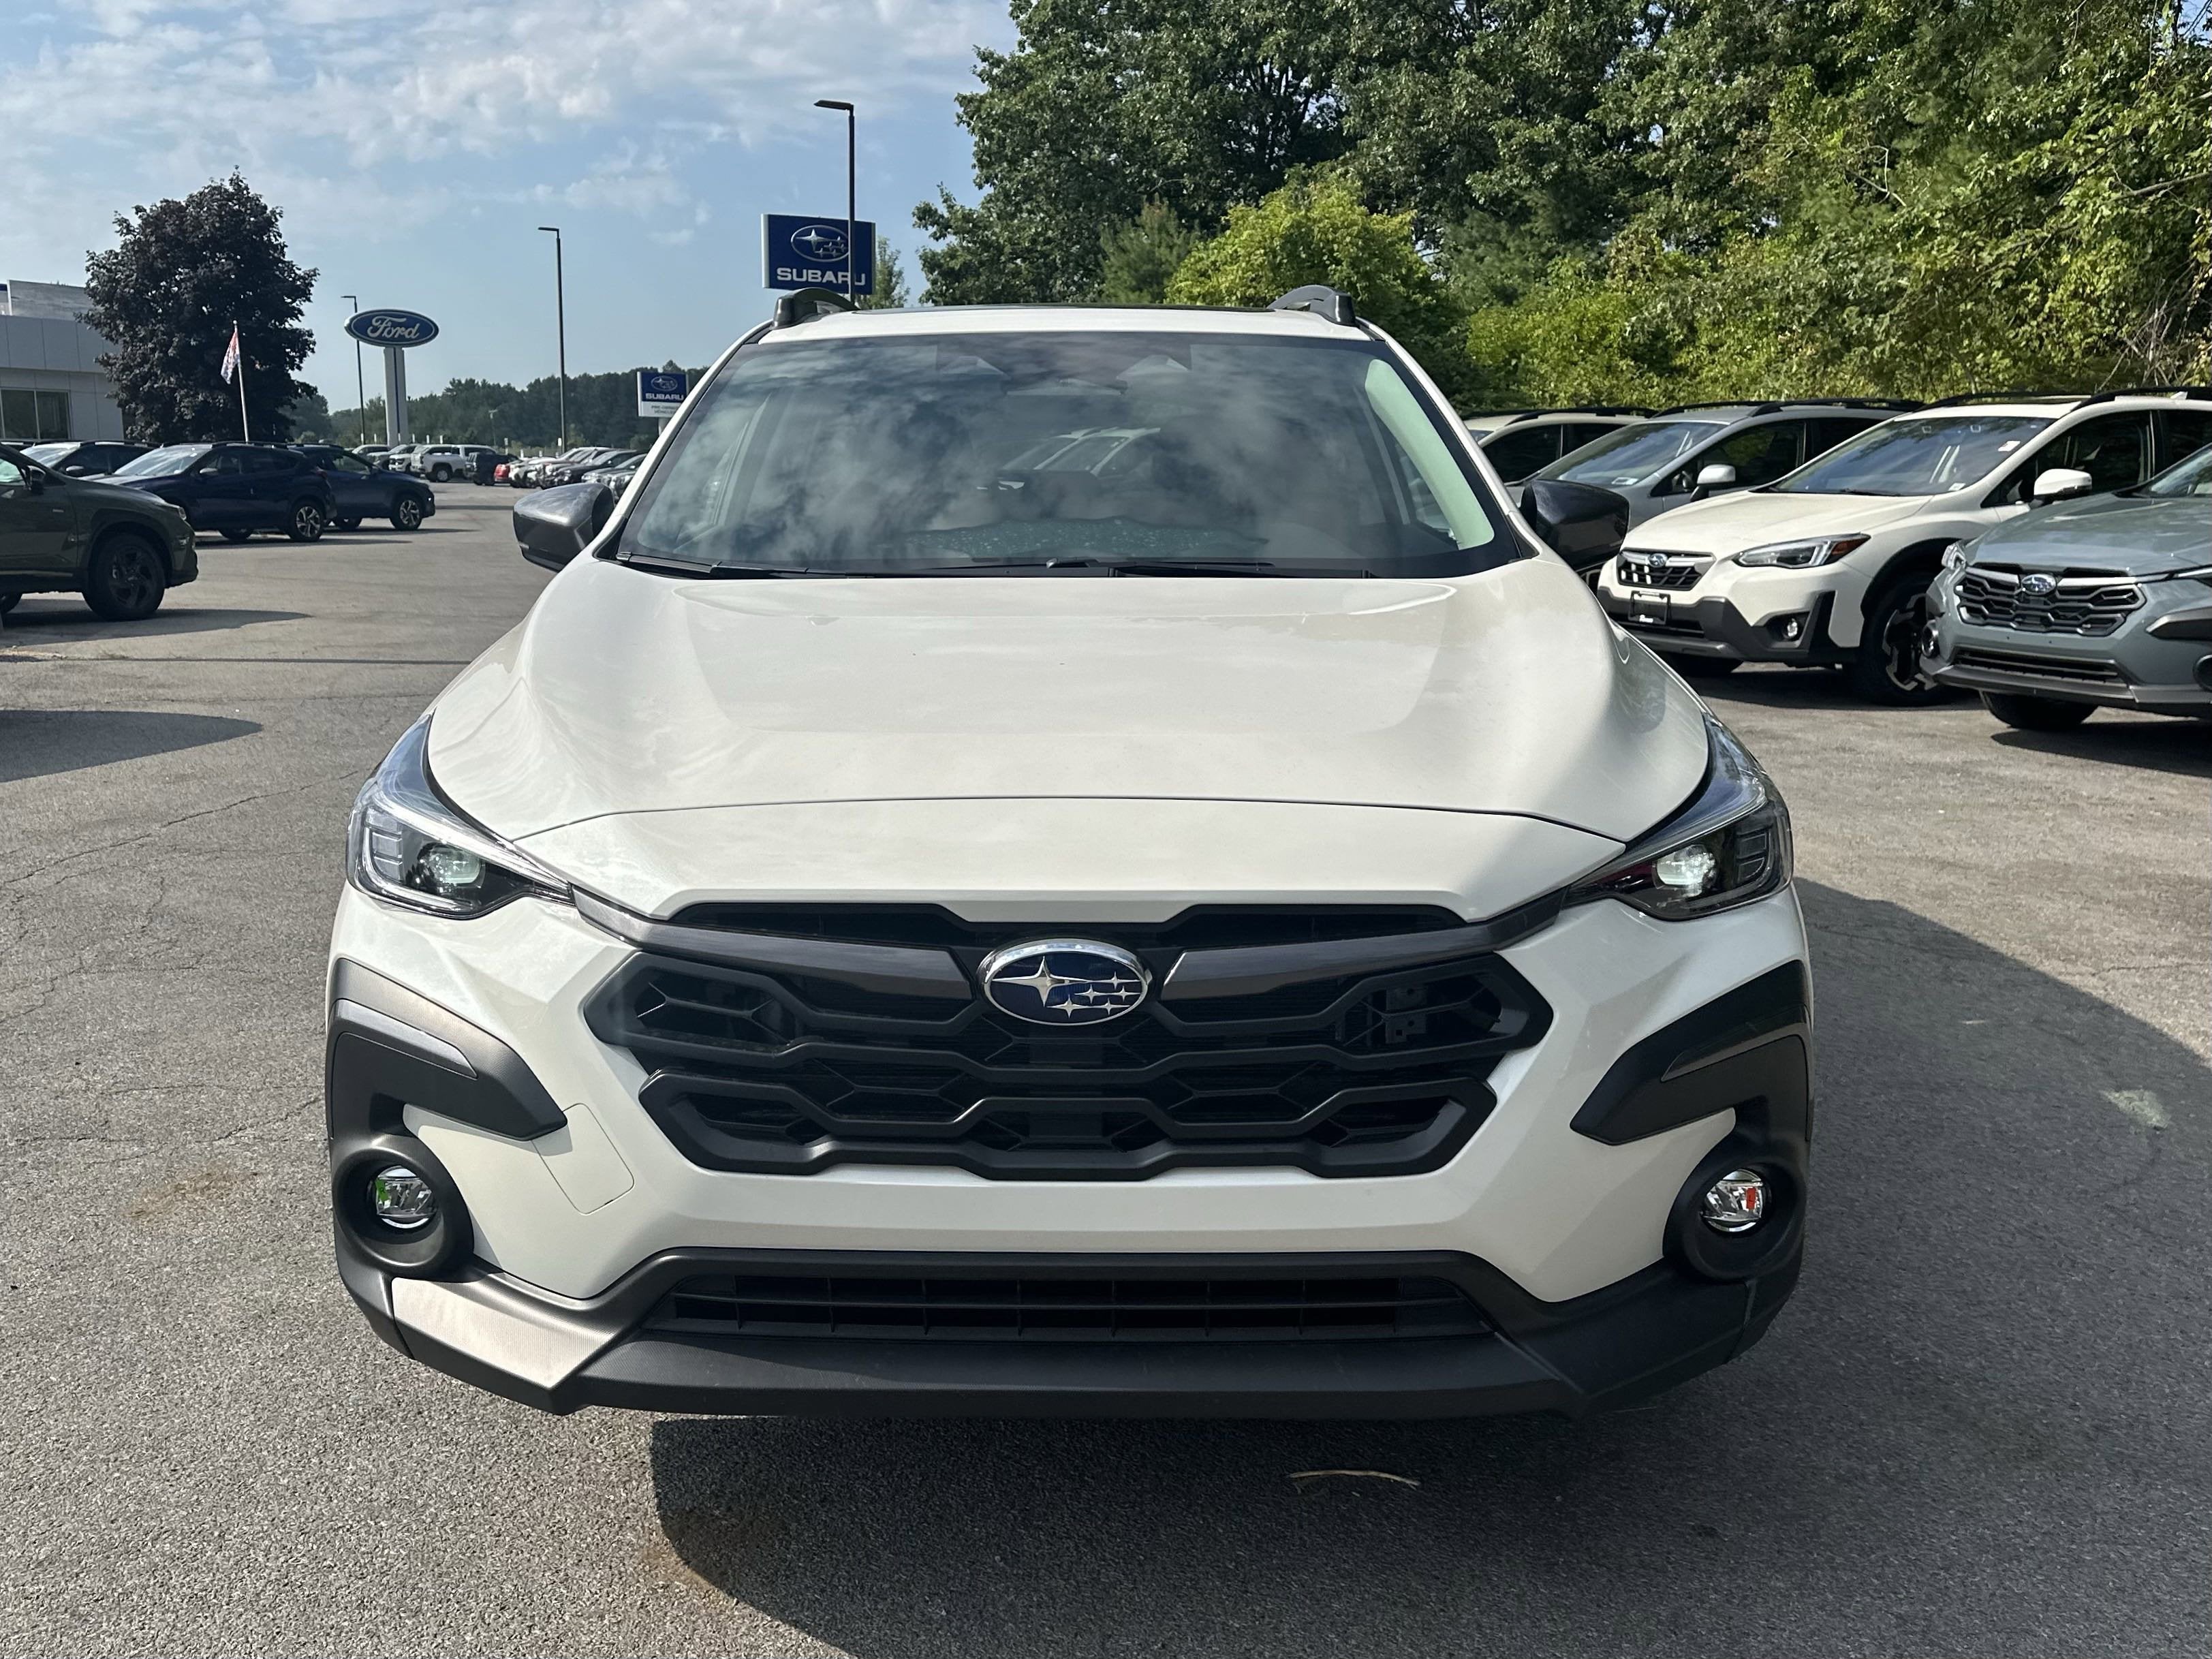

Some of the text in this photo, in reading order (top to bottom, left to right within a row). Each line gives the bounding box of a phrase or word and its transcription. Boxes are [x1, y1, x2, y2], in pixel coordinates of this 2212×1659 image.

[777, 267, 865, 285] SUBARU
[367, 315, 420, 339] Ford
[645, 392, 684, 401] SUBARU
